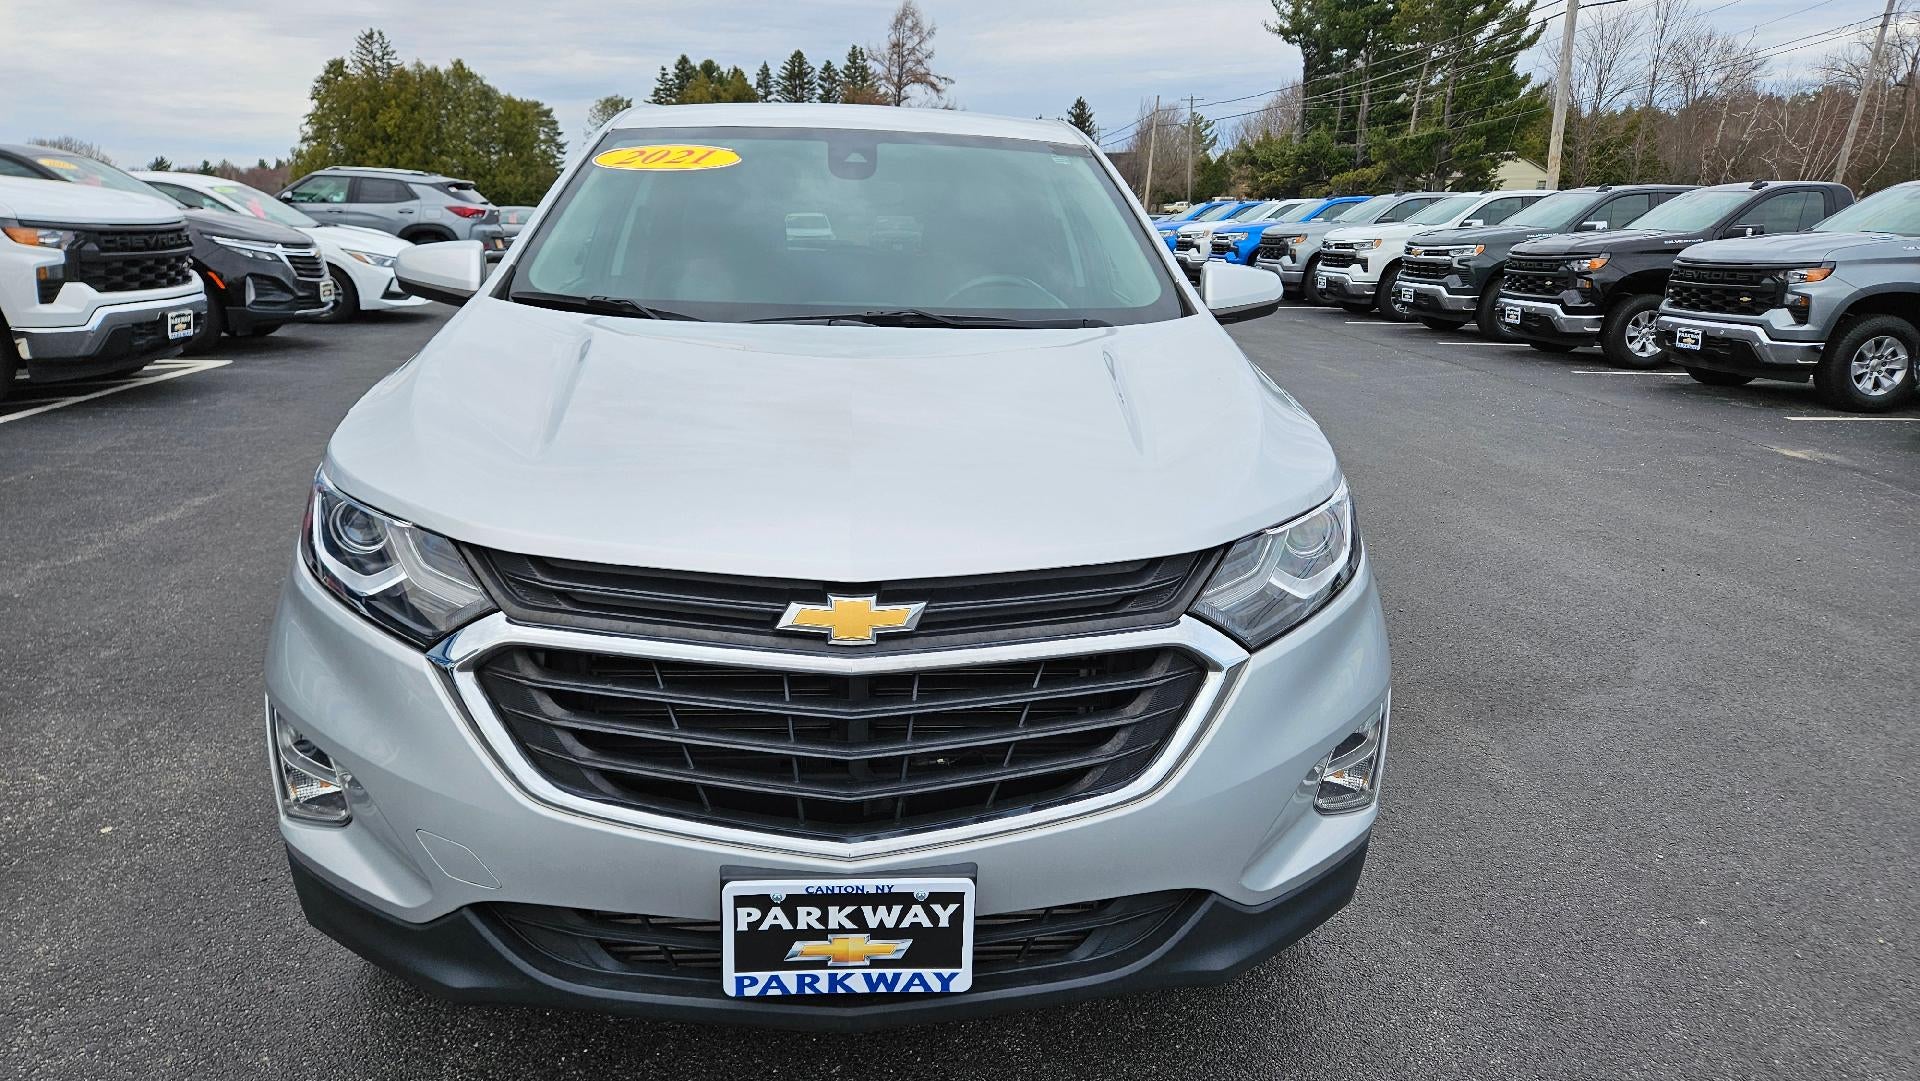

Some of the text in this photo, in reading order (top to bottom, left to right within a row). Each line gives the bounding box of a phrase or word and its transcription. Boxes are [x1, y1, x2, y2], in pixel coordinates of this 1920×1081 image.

[614, 149, 717, 165] 2021
[875, 884, 895, 894] NY
[736, 903, 961, 932] PARKWAY
[734, 972, 960, 997] PARKWAY
